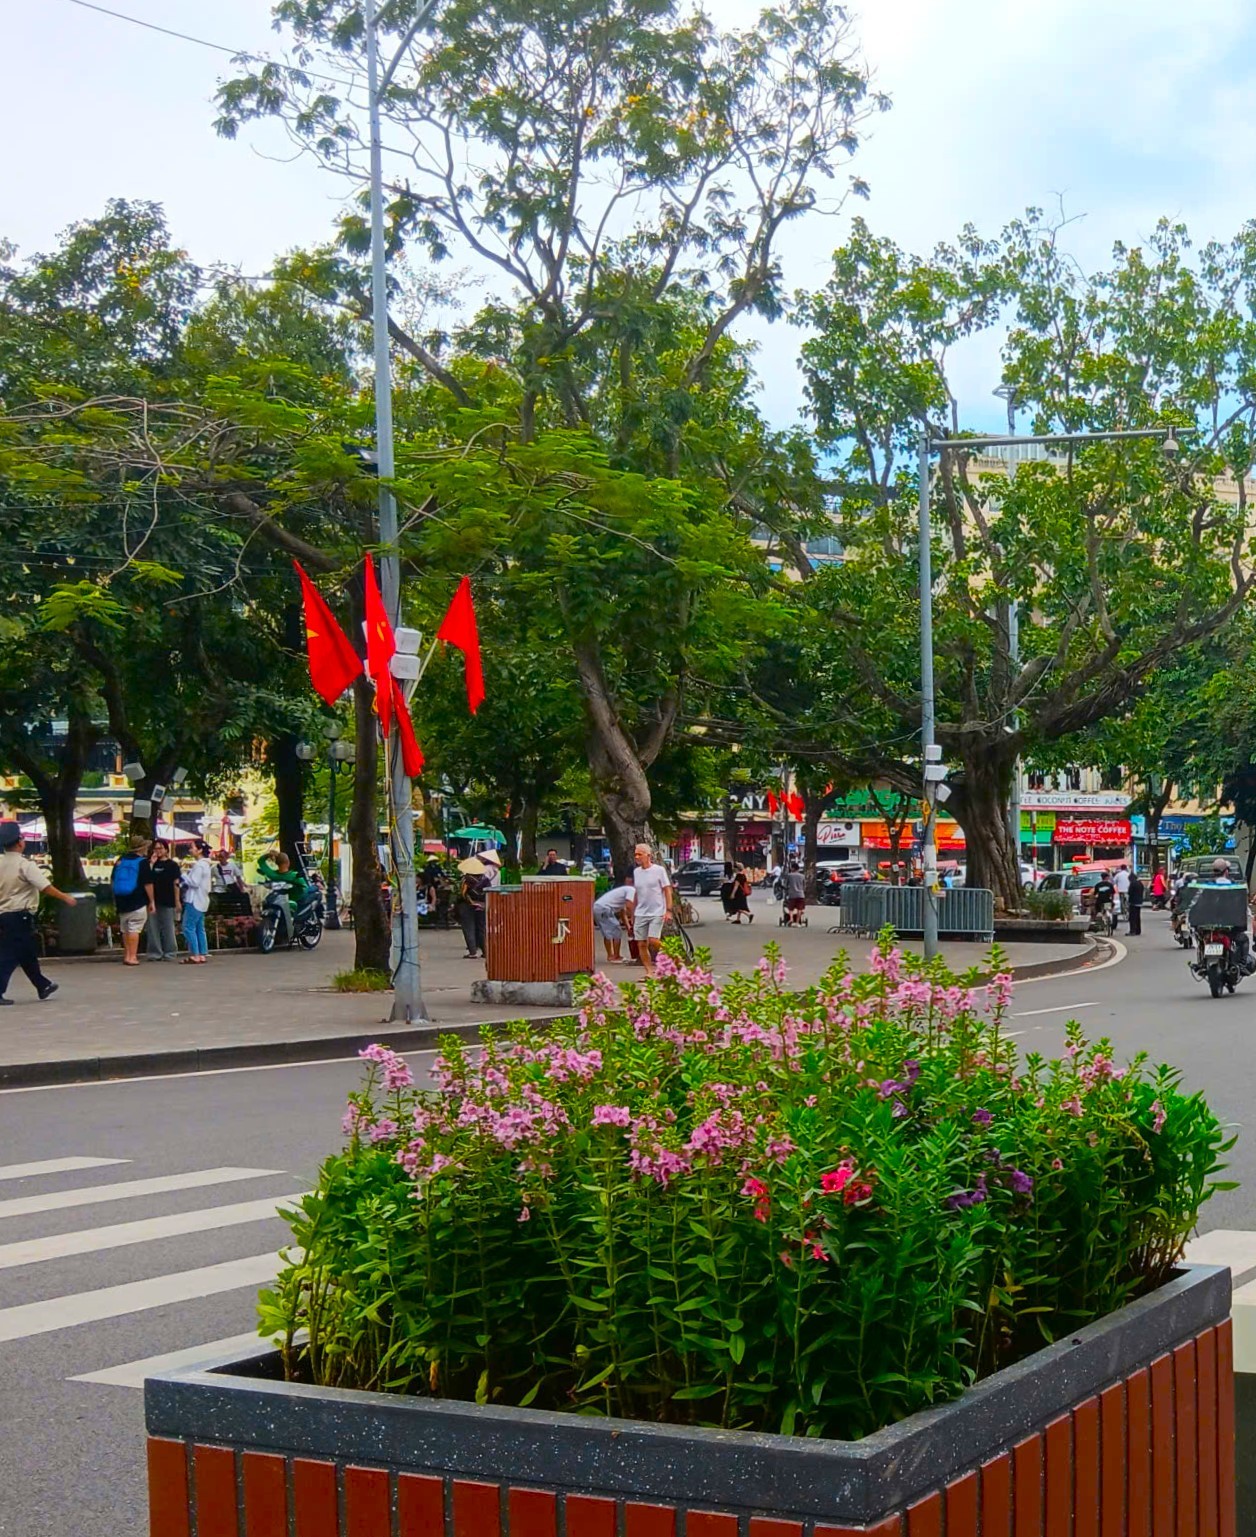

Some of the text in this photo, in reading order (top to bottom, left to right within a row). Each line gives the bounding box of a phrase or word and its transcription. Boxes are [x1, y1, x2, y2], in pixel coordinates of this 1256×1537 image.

[1058, 825, 1127, 834] THE NOTE COFFEE
